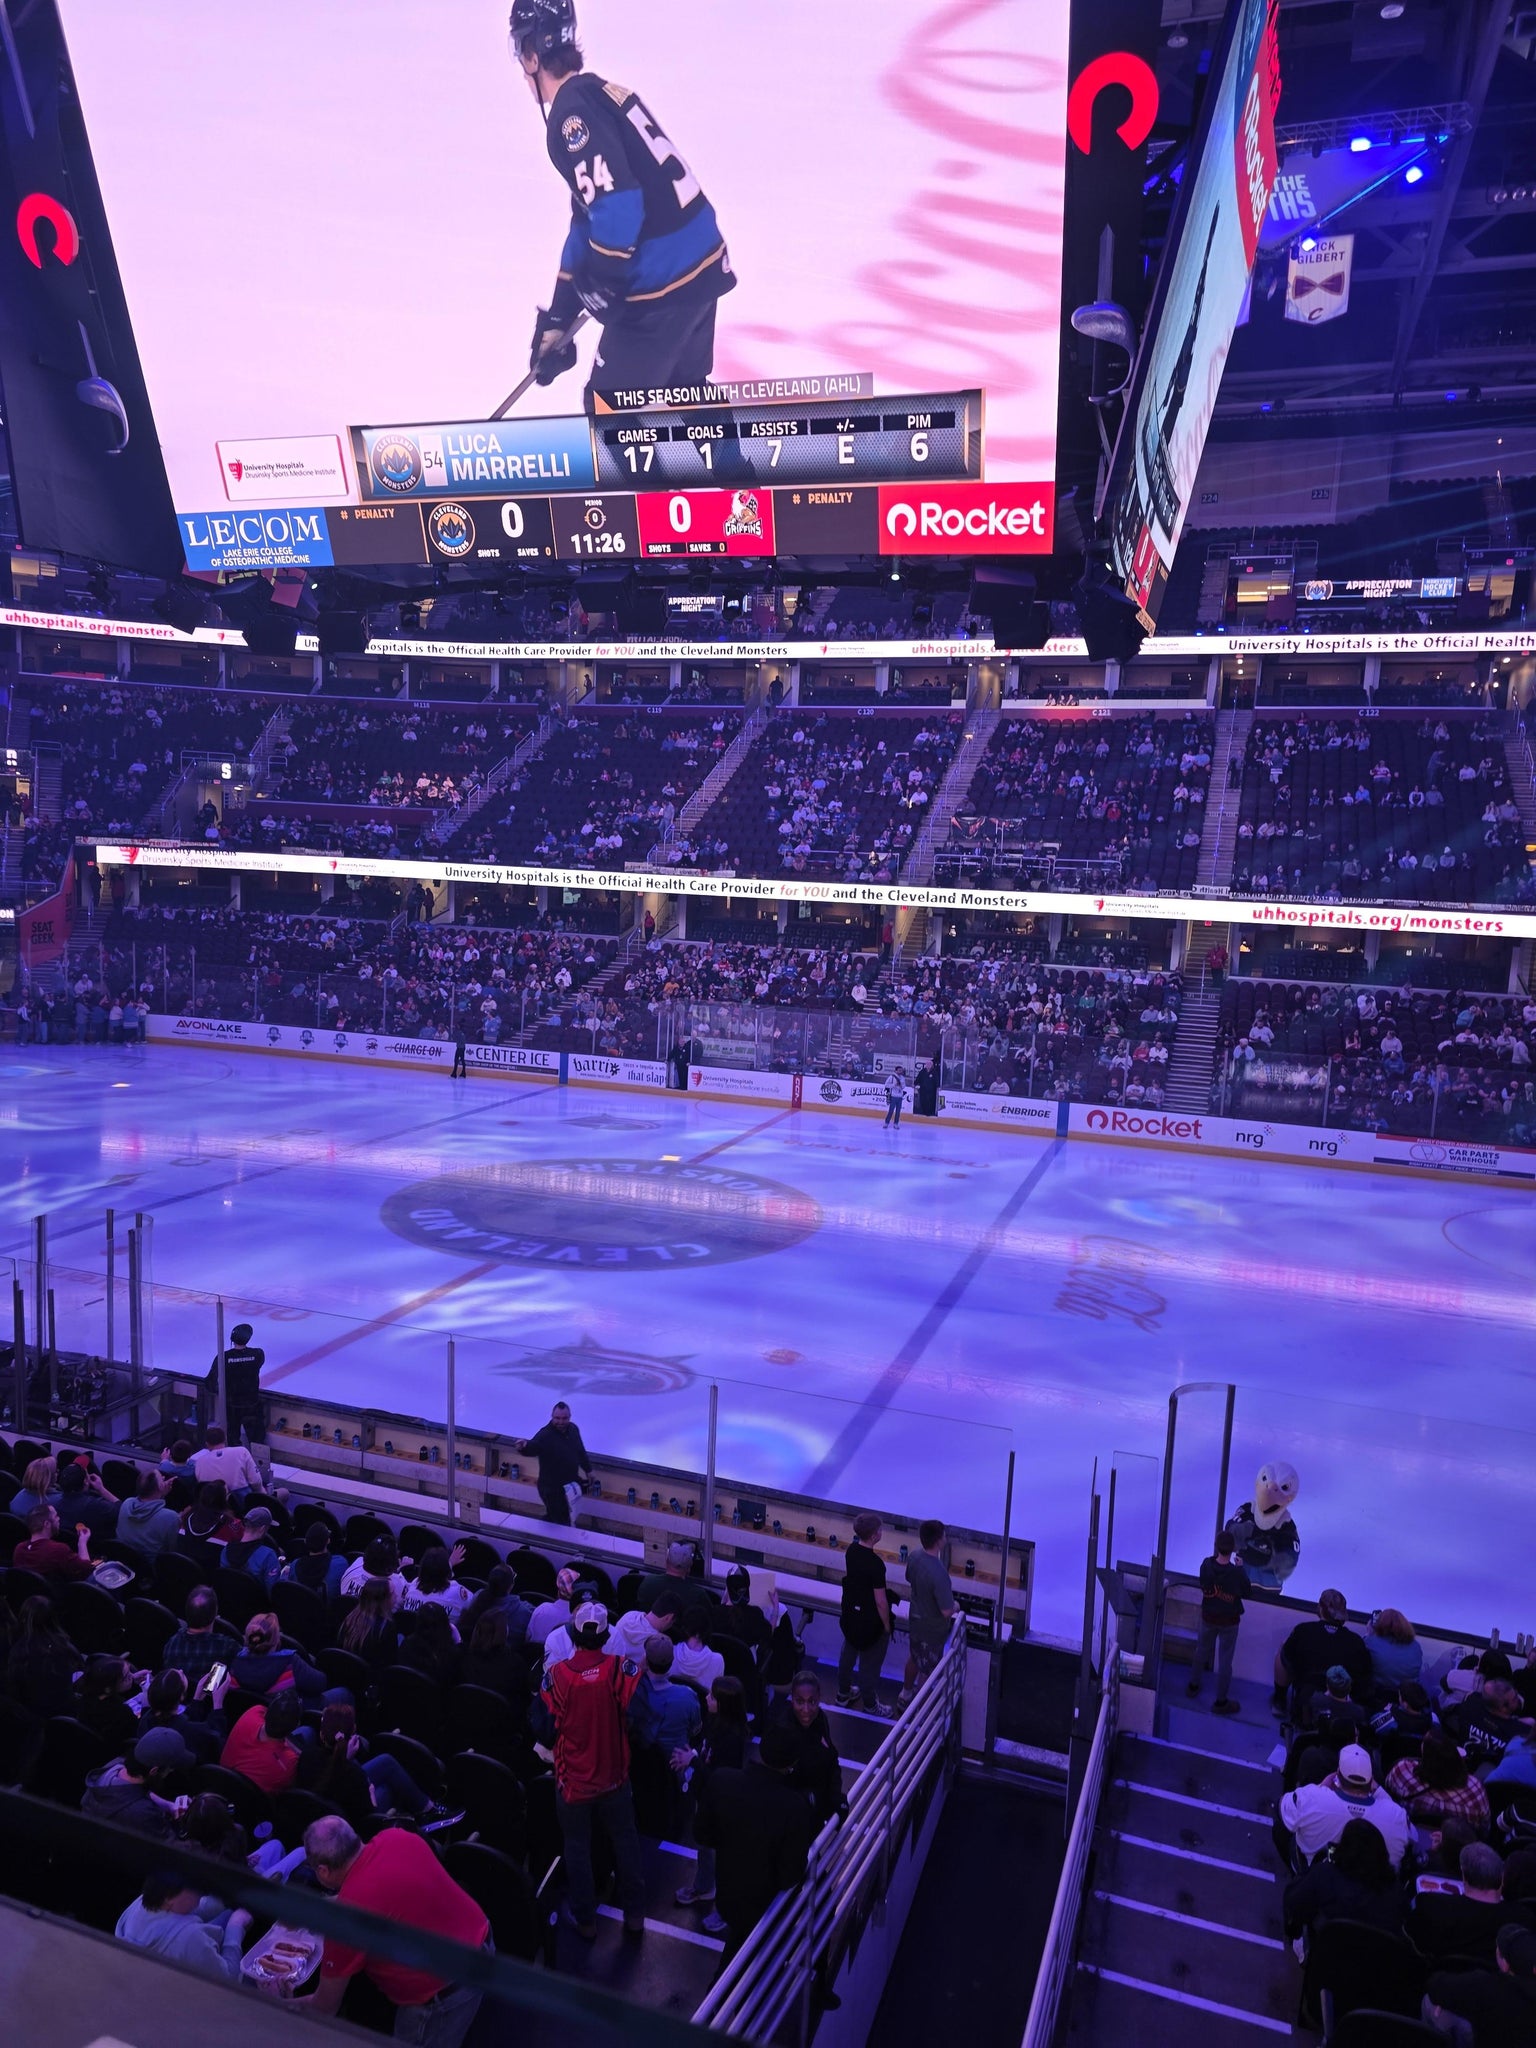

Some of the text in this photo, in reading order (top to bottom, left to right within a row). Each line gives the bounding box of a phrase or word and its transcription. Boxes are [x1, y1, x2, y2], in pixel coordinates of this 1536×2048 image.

[574, 154, 614, 205] 54
[1297, 251, 1345, 264] GILBERT
[614, 376, 861, 407] THIS SEASON WITH CLEVELAND (AHL)
[751, 421, 798, 437] ASSISTS
[836, 418, 854, 432] +/-
[907, 414, 931, 429] PIM
[618, 429, 658, 443] GAMES
[687, 425, 724, 440] GOALS
[447, 434, 502, 455] LUCA
[838, 435, 854, 464] E
[910, 432, 929, 461] 6
[424, 451, 443, 469] 54
[623, 446, 654, 473] 17
[699, 442, 713, 470] 1
[767, 439, 782, 467] 7
[243, 463, 275, 472] University
[276, 461, 305, 470] Hospitals
[290, 469, 314, 477] Medicine
[451, 453, 570, 481] MARRELLI
[383, 474, 416, 490] MONSTERS
[809, 491, 853, 504] PENALTY
[1201, 493, 1218, 504] 224
[354, 508, 394, 519] PENALTY
[433, 506, 467, 521] CLEVELAND
[501, 501, 524, 538] 0
[592, 512, 598, 523] 0
[669, 495, 692, 533] 0
[920, 500, 1045, 536] Rocket
[184, 512, 323, 549] LECOM
[724, 520, 762, 537] GRIFFINS
[438, 540, 470, 555] MONSTERS
[570, 532, 626, 554] 11:26
[648, 543, 671, 553] SHOTS
[689, 542, 725, 553] SAVES 0
[223, 546, 293, 558] LAKE ERIE COLLEGE
[478, 548, 500, 558] SHOTS
[517, 546, 551, 557] SAVES 0
[211, 554, 310, 567] OF OSTEOPATHIC MEDICINE
[1345, 579, 1412, 590] APPRECIATION
[1423, 583, 1453, 591] HOCKEY
[1362, 588, 1392, 598] NIGHT
[1427, 589, 1447, 597] CLUB
[668, 596, 716, 606] APPRECIATION
[680, 603, 701, 612] NIGHT
[5, 612, 175, 638] uhhospitals.org/monsters
[415, 645, 424, 653] is
[428, 645, 445, 653] the
[447, 645, 486, 655] Official
[489, 646, 521, 655] Health
[523, 646, 546, 655] Care
[549, 646, 592, 656] Provider
[595, 646, 611, 655] for
[614, 646, 636, 655] YOU
[637, 646, 657, 656] and
[659, 646, 677, 655] the
[680, 646, 734, 656] Cleveland
[736, 646, 788, 655] Monsters
[1228, 634, 1535, 653] University Hospitals is the Official Health
[184, 857, 211, 867] Sports
[252, 860, 283, 869] Institute
[446, 866, 1028, 908] University Hospitals is the Official Health Care Provider for YOU and the Cleveland Monsters
[31, 920, 54, 932] SEAT
[1252, 906, 1504, 932] uhhospitals.org/monsters
[31, 932, 55, 944] GEEK
[176, 1019, 242, 1034] AVONLAKE
[394, 1042, 427, 1055] CHARGE
[476, 1047, 526, 1064] CENTER
[530, 1052, 549, 1066] ICE
[628, 1070, 665, 1085] that slap
[1001, 1106, 1051, 1119] ENBRIDGE
[1111, 1111, 1202, 1139] Rocket
[1236, 1131, 1264, 1148] nrg
[1309, 1139, 1338, 1156] nrg
[1448, 1148, 1500, 1159] CAR PARTS
[1449, 1155, 1497, 1165] WAREHOUSE
[410, 1207, 711, 1261] CLEVELAND
[581, 1668, 600, 1677] CCM
